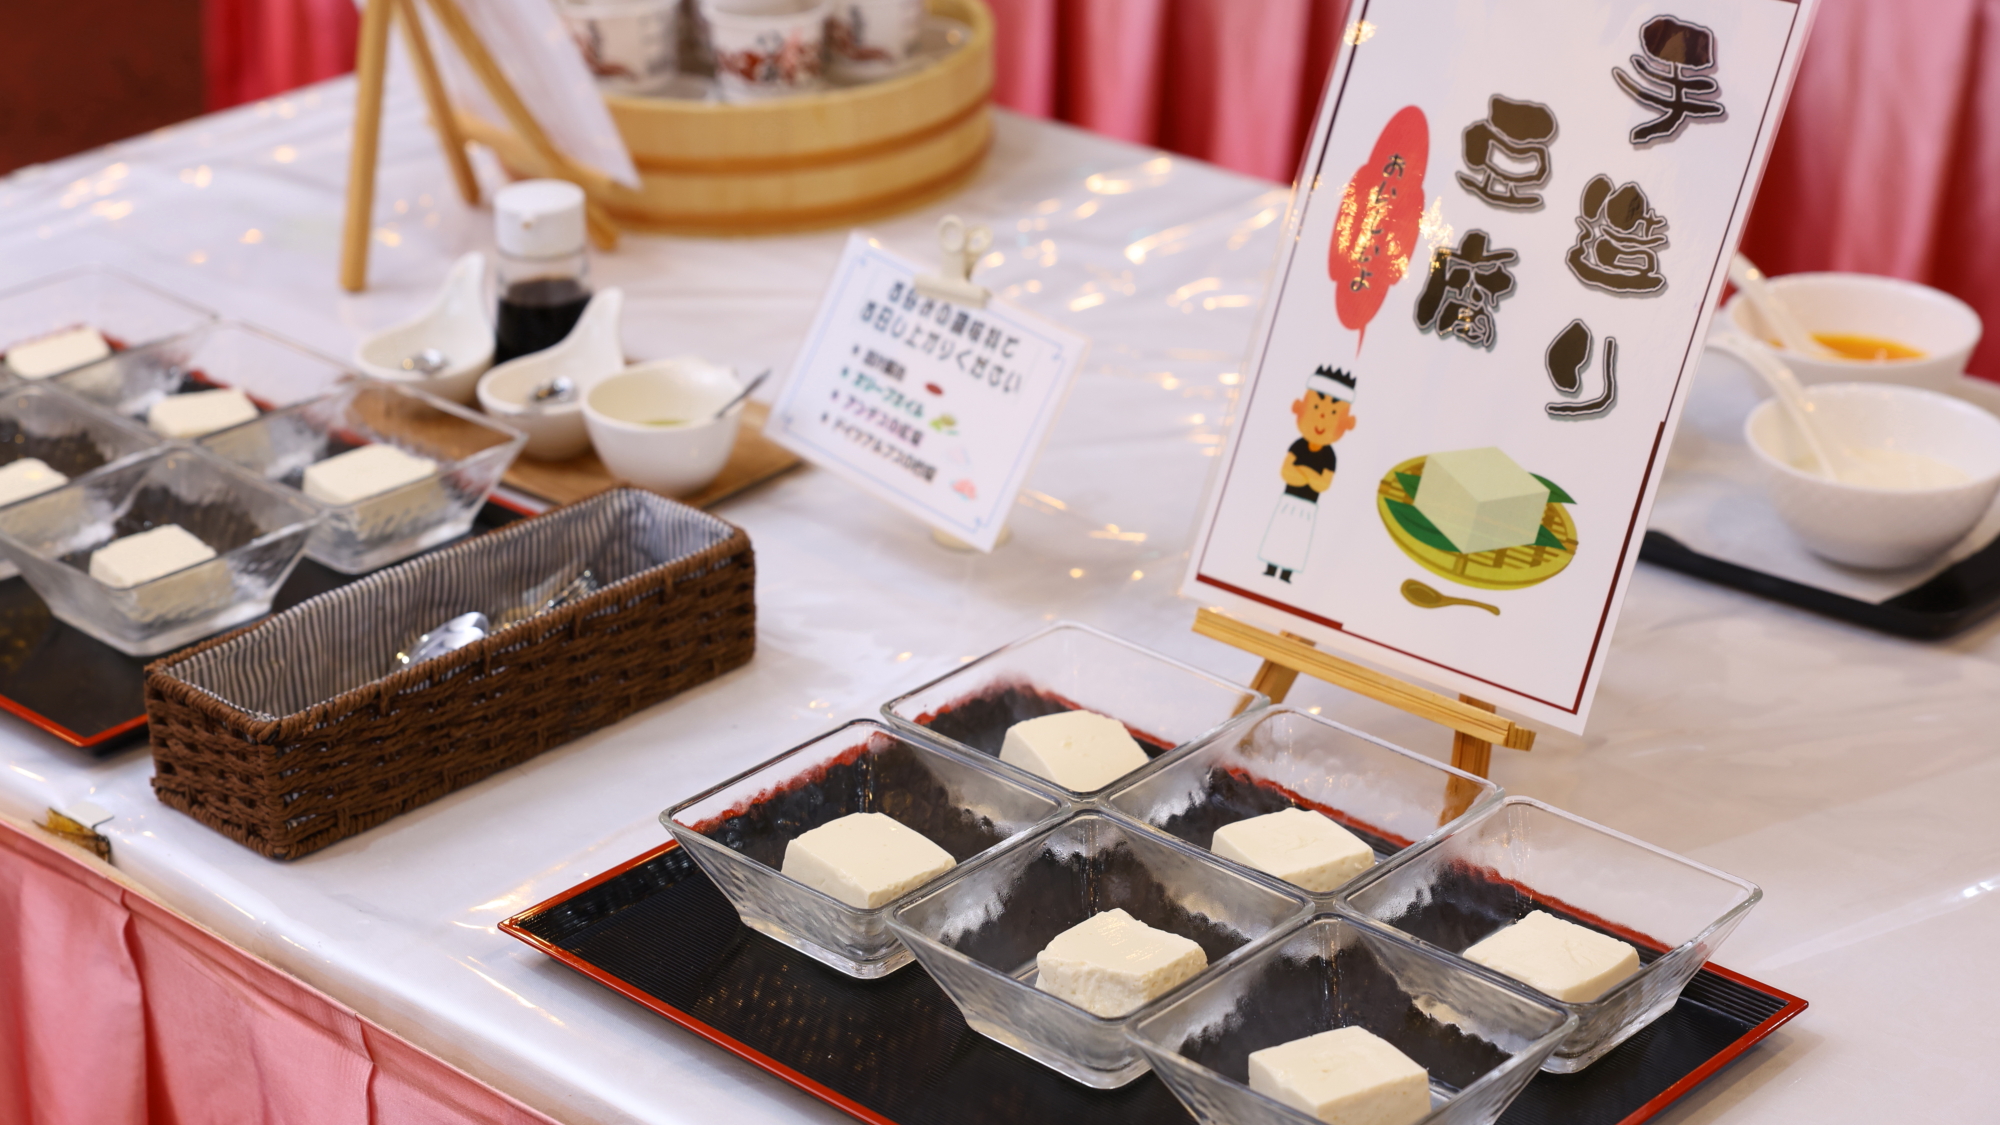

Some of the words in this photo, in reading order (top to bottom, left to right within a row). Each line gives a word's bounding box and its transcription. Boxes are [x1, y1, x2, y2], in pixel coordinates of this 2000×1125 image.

[1350, 153, 1406, 292] おいしいよ
[1413, 92, 1559, 350] 豆腐
[1546, 14, 1727, 420] 手造り
[853, 371, 925, 418] オリーブオイル
[861, 301, 1021, 393] お召し上がりください
